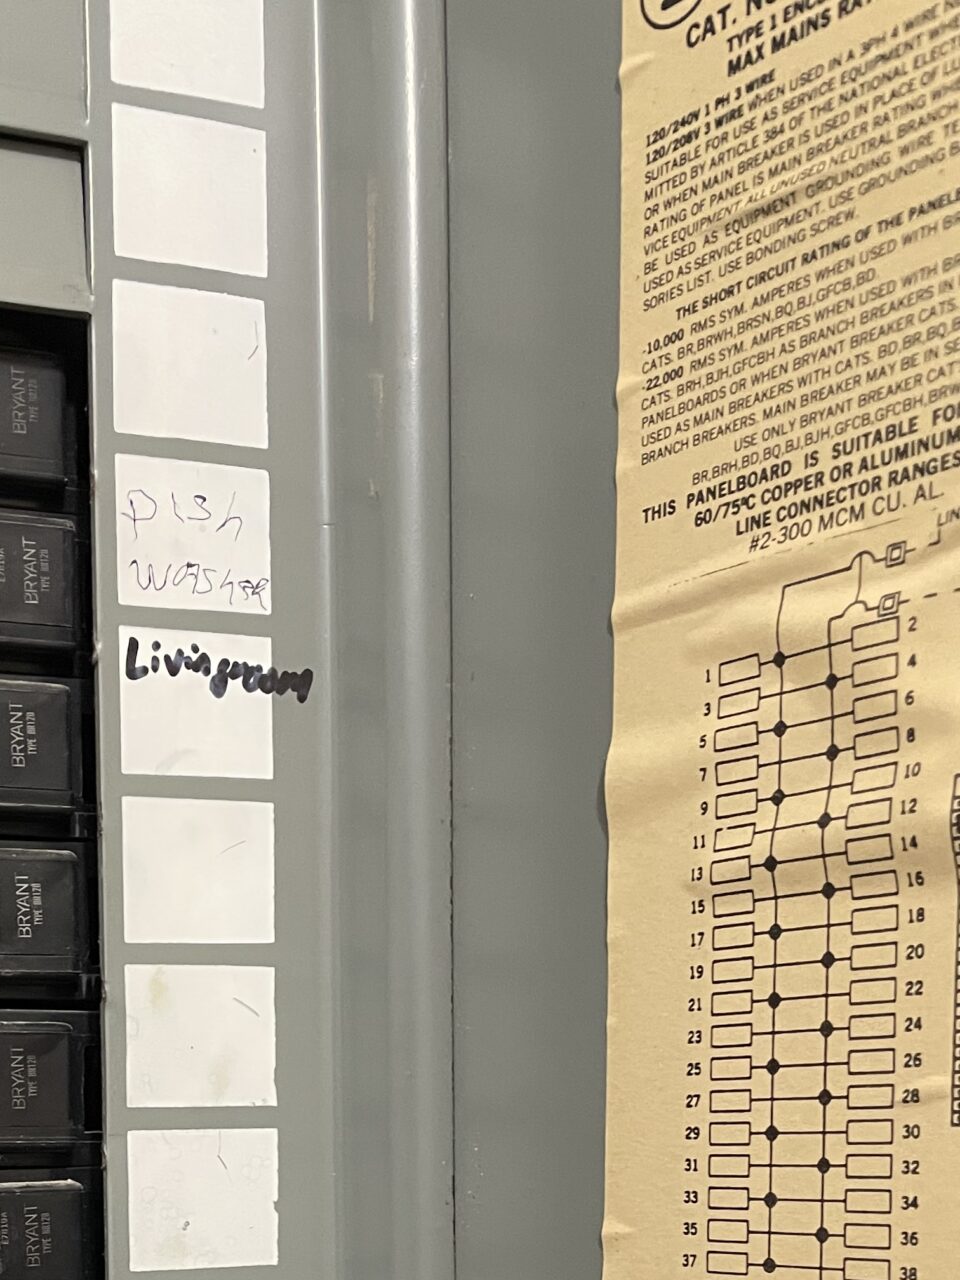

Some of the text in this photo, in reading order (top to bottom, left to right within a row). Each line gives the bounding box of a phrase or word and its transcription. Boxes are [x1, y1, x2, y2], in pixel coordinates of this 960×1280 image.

[686, 4, 737, 48] CAT.
[727, 14, 777, 52] TYPE 1
[727, 8, 831, 77] MAX MAINS
[715, 92, 730, 110] PH
[735, 87, 742, 101] 3
[745, 68, 776, 94] WIRE
[676, 211, 905, 320] THE SHORT CIRCUIT RATING OF THE
[10, 366, 26, 434] BRYANT
[641, 438, 689, 466] BRANCH
[762, 400, 797, 421] MAIN
[800, 375, 862, 407] BREAKER
[734, 398, 853, 452] USE ONLY BRYANT
[642, 416, 920, 525] THIS PANELBOARD IS SUITABLE
[760, 468, 825, 506] COPPER
[829, 460, 850, 486] OR
[735, 476, 882, 536] LINE CONNECTOR
[748, 481, 945, 553] #2-300 MCM CU. AL.
[21, 536, 39, 605] BRYANT
[907, 617, 918, 632] 2
[704, 669, 711, 683] 1
[8, 703, 24, 768] BRYANT
[904, 762, 922, 778] 10
[700, 801, 708, 815] 9
[15, 874, 32, 939] BRYANT
[907, 908, 925, 923] 18
[690, 932, 705, 947] 17
[8, 1048, 26, 1110] BRYANT
[686, 1062, 702, 1076] 25
[903, 1053, 922, 1068] 26
[683, 1191, 699, 1204] 33
[900, 1196, 920, 1210] 34
[23, 1205, 40, 1267] BRYANT
[682, 1254, 697, 1268] 37
